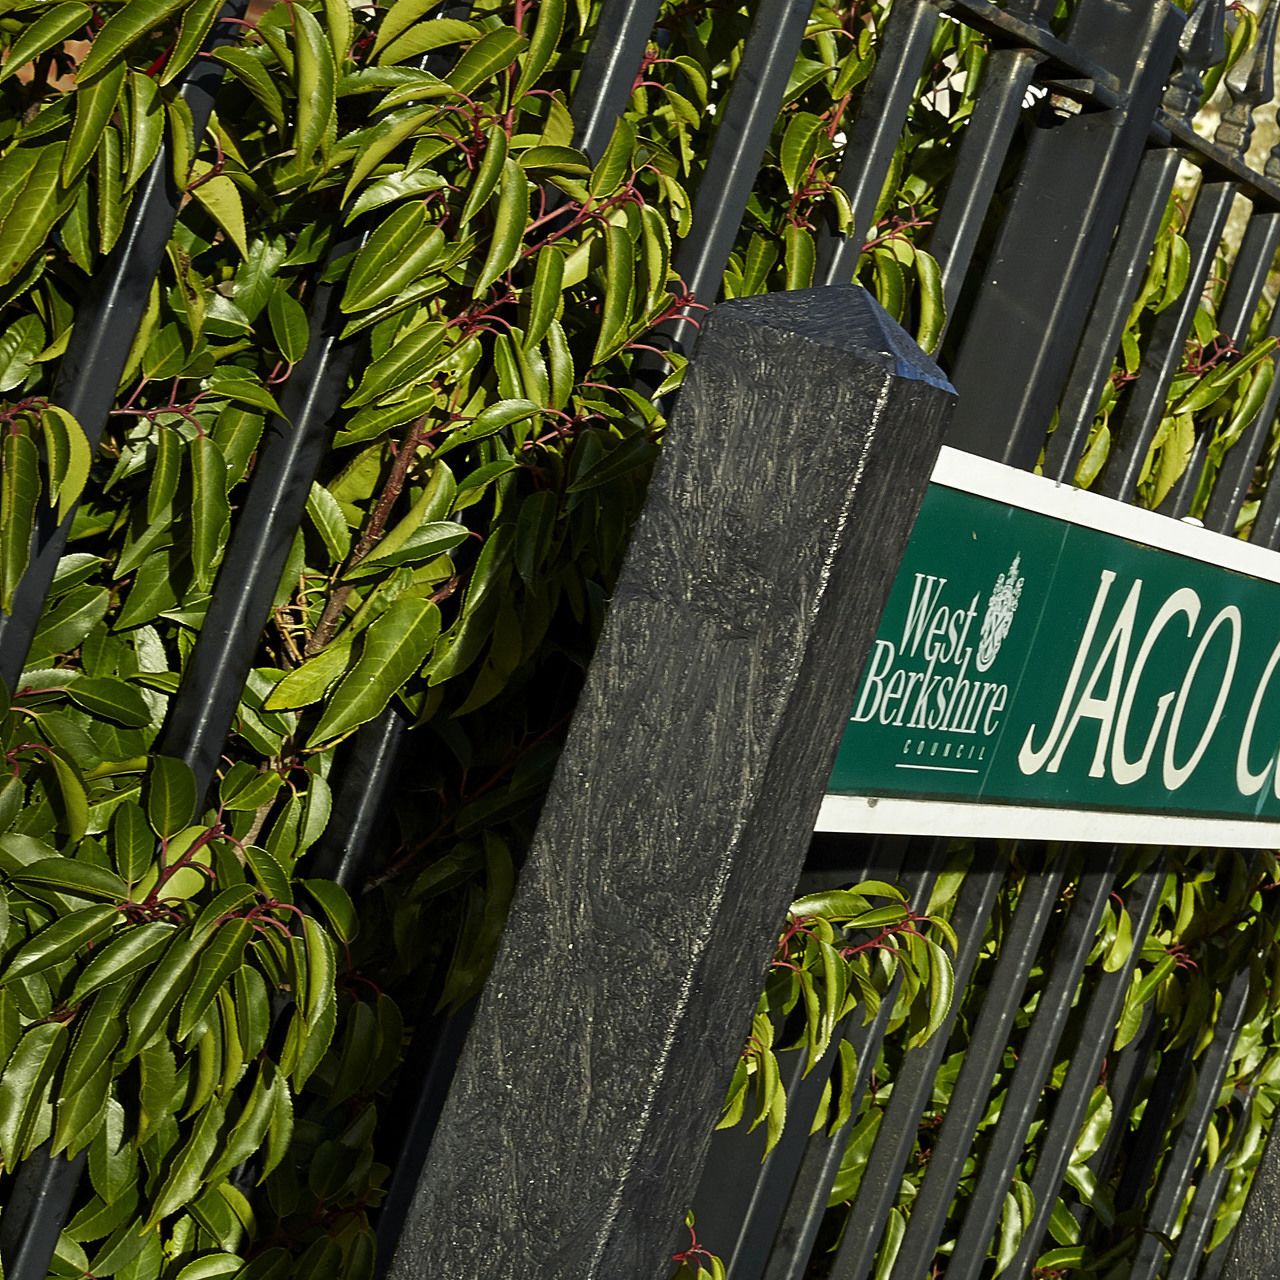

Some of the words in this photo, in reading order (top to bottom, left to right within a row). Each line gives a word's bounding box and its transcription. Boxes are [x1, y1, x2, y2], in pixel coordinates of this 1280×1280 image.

[899, 573, 980, 665] West
[850, 640, 1008, 735] Berkshire
[1017, 569, 1242, 791] JAGO
[903, 739, 986, 760] COUNCIL
